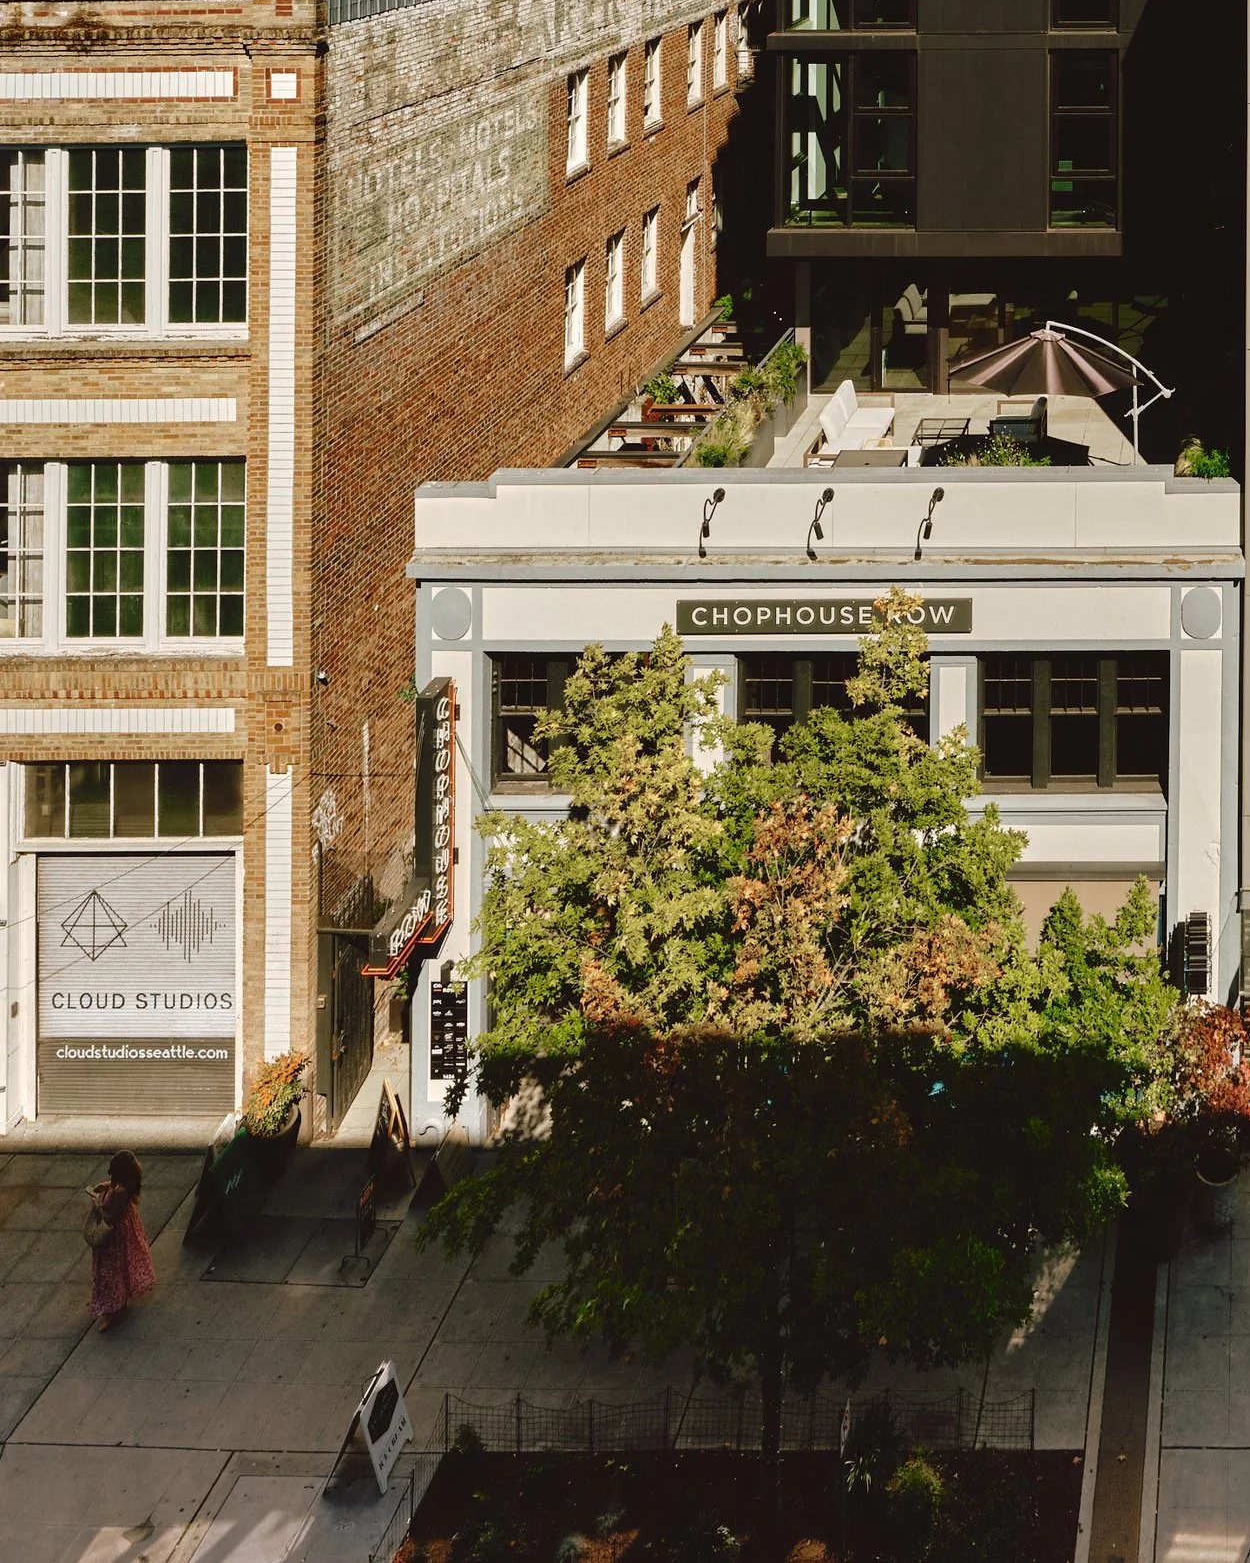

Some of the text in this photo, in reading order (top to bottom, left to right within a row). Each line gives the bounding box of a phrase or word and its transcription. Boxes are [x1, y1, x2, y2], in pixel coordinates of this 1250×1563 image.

[691, 606, 873, 626] CHOPHOUSE
[389, 696, 450, 957] CHOPHOUSE ROW
[52, 992, 233, 1010] CLOUD STUDIOS
[56, 1044, 228, 1060] cloudstudiosseattle.com
